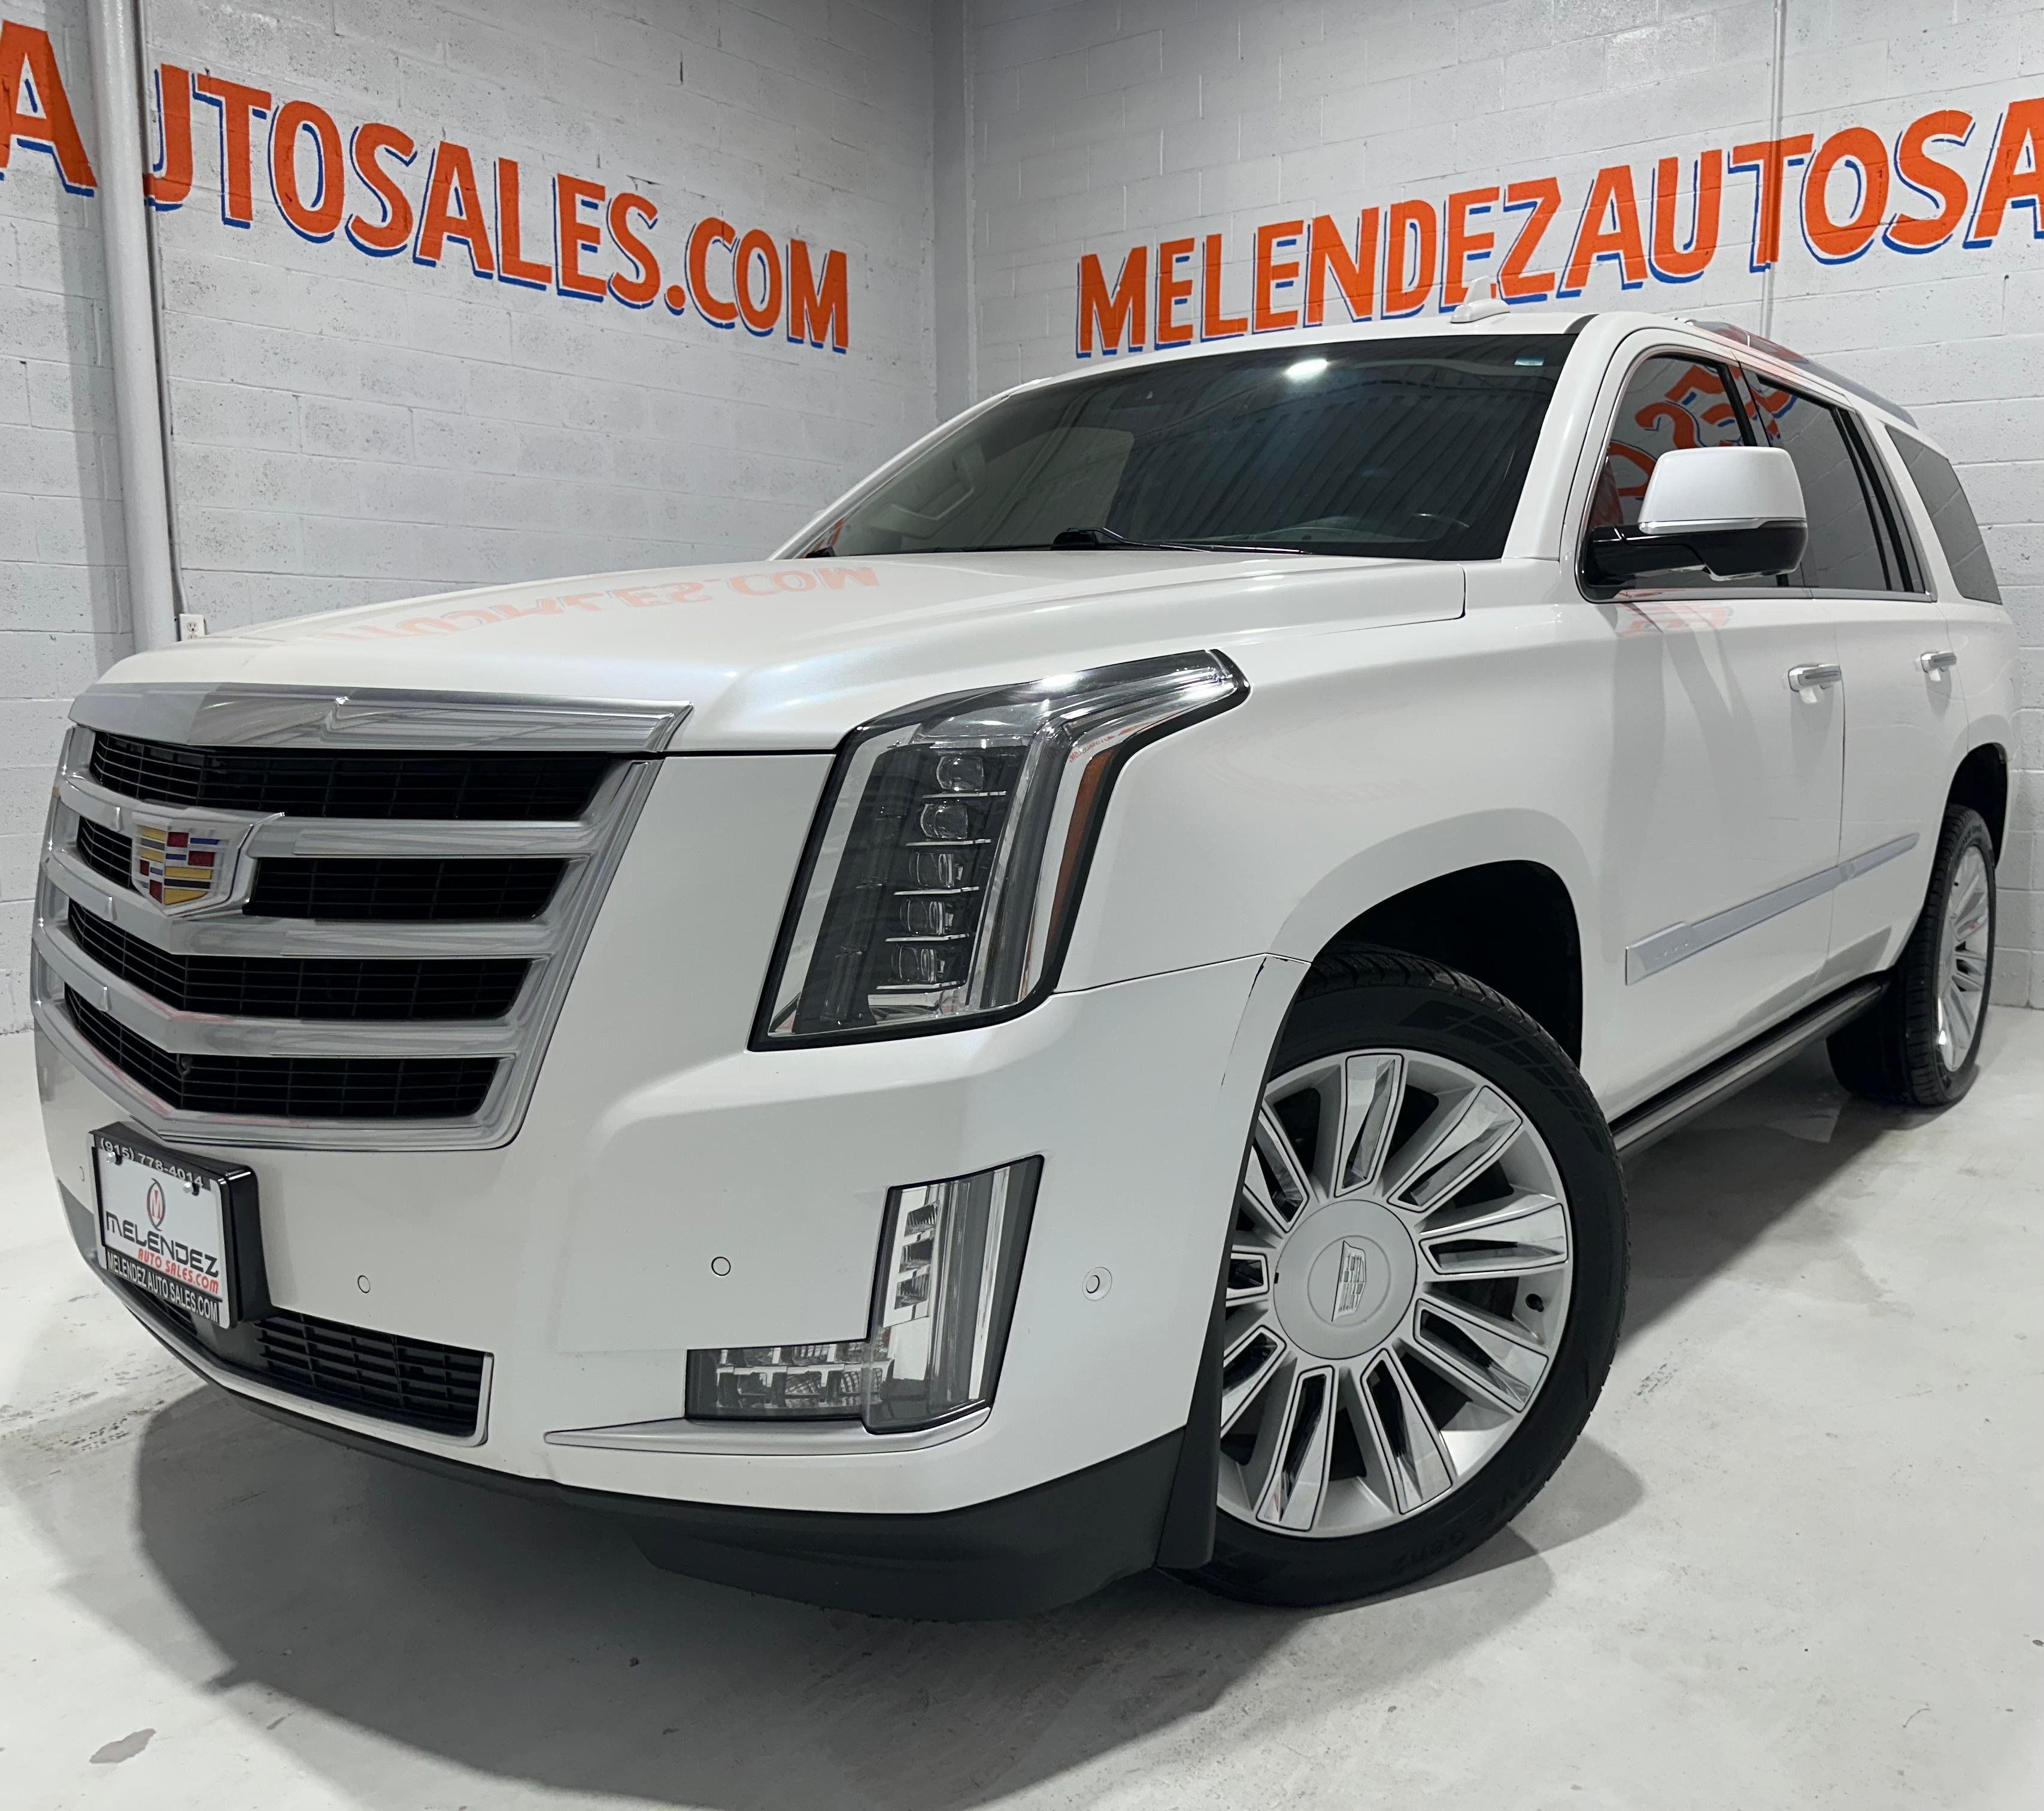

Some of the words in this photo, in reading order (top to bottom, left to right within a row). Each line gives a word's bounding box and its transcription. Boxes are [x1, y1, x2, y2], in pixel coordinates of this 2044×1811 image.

[101, 1138, 134, 1161] (915)
[138, 1153, 204, 1188] 778-4014
[106, 1211, 219, 1278] MELENDEZ
[138, 1247, 162, 1269] AUTO
[165, 1259, 219, 1294] SALES.COM
[107, 1251, 147, 1288] MELENDEZ
[148, 1271, 168, 1299] AUTO
[170, 1282, 219, 1323] SALES.COM
